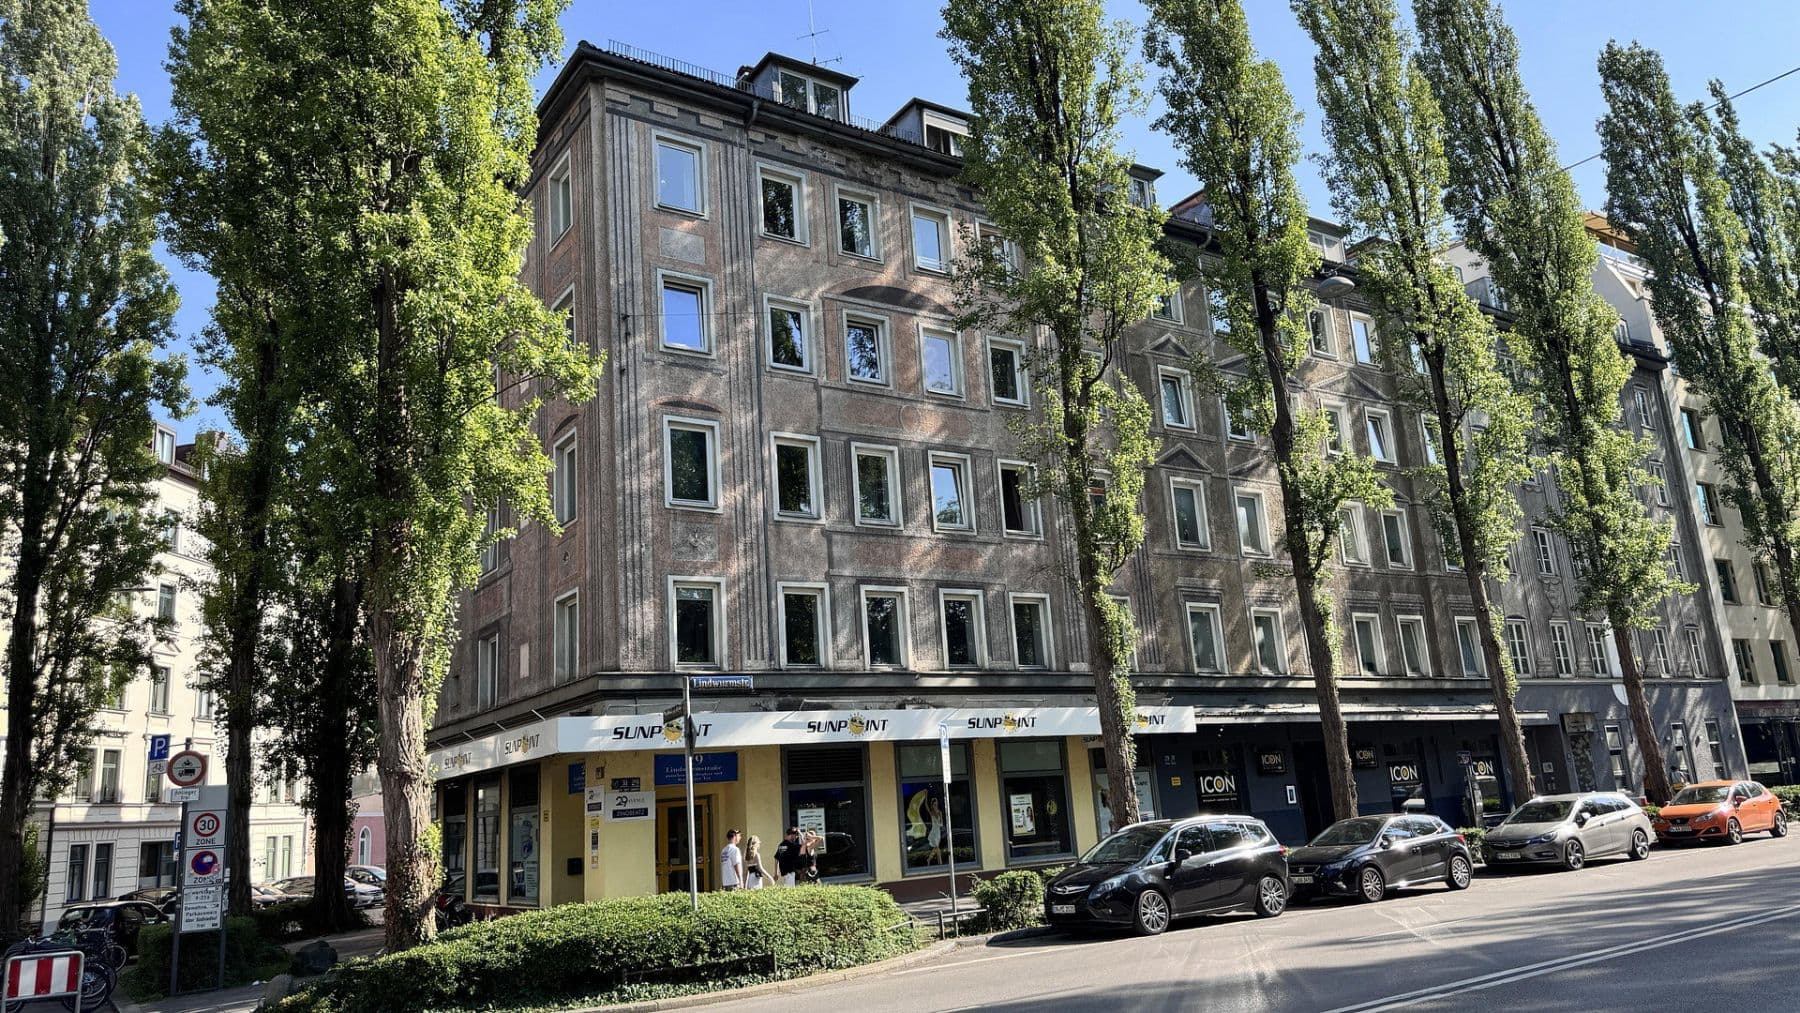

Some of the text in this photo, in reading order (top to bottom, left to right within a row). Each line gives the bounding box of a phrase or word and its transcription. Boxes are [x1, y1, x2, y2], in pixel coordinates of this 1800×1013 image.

[807, 714, 889, 736] SUNPOINT
[967, 712, 1037, 733] SUNPOINT
[154, 737, 166, 757] P
[1261, 754, 1282, 765] ICON
[1469, 760, 1495, 777] ICON
[1389, 765, 1419, 782] ICON
[1199, 775, 1236, 794] ICON
[199, 819, 215, 831] 30
